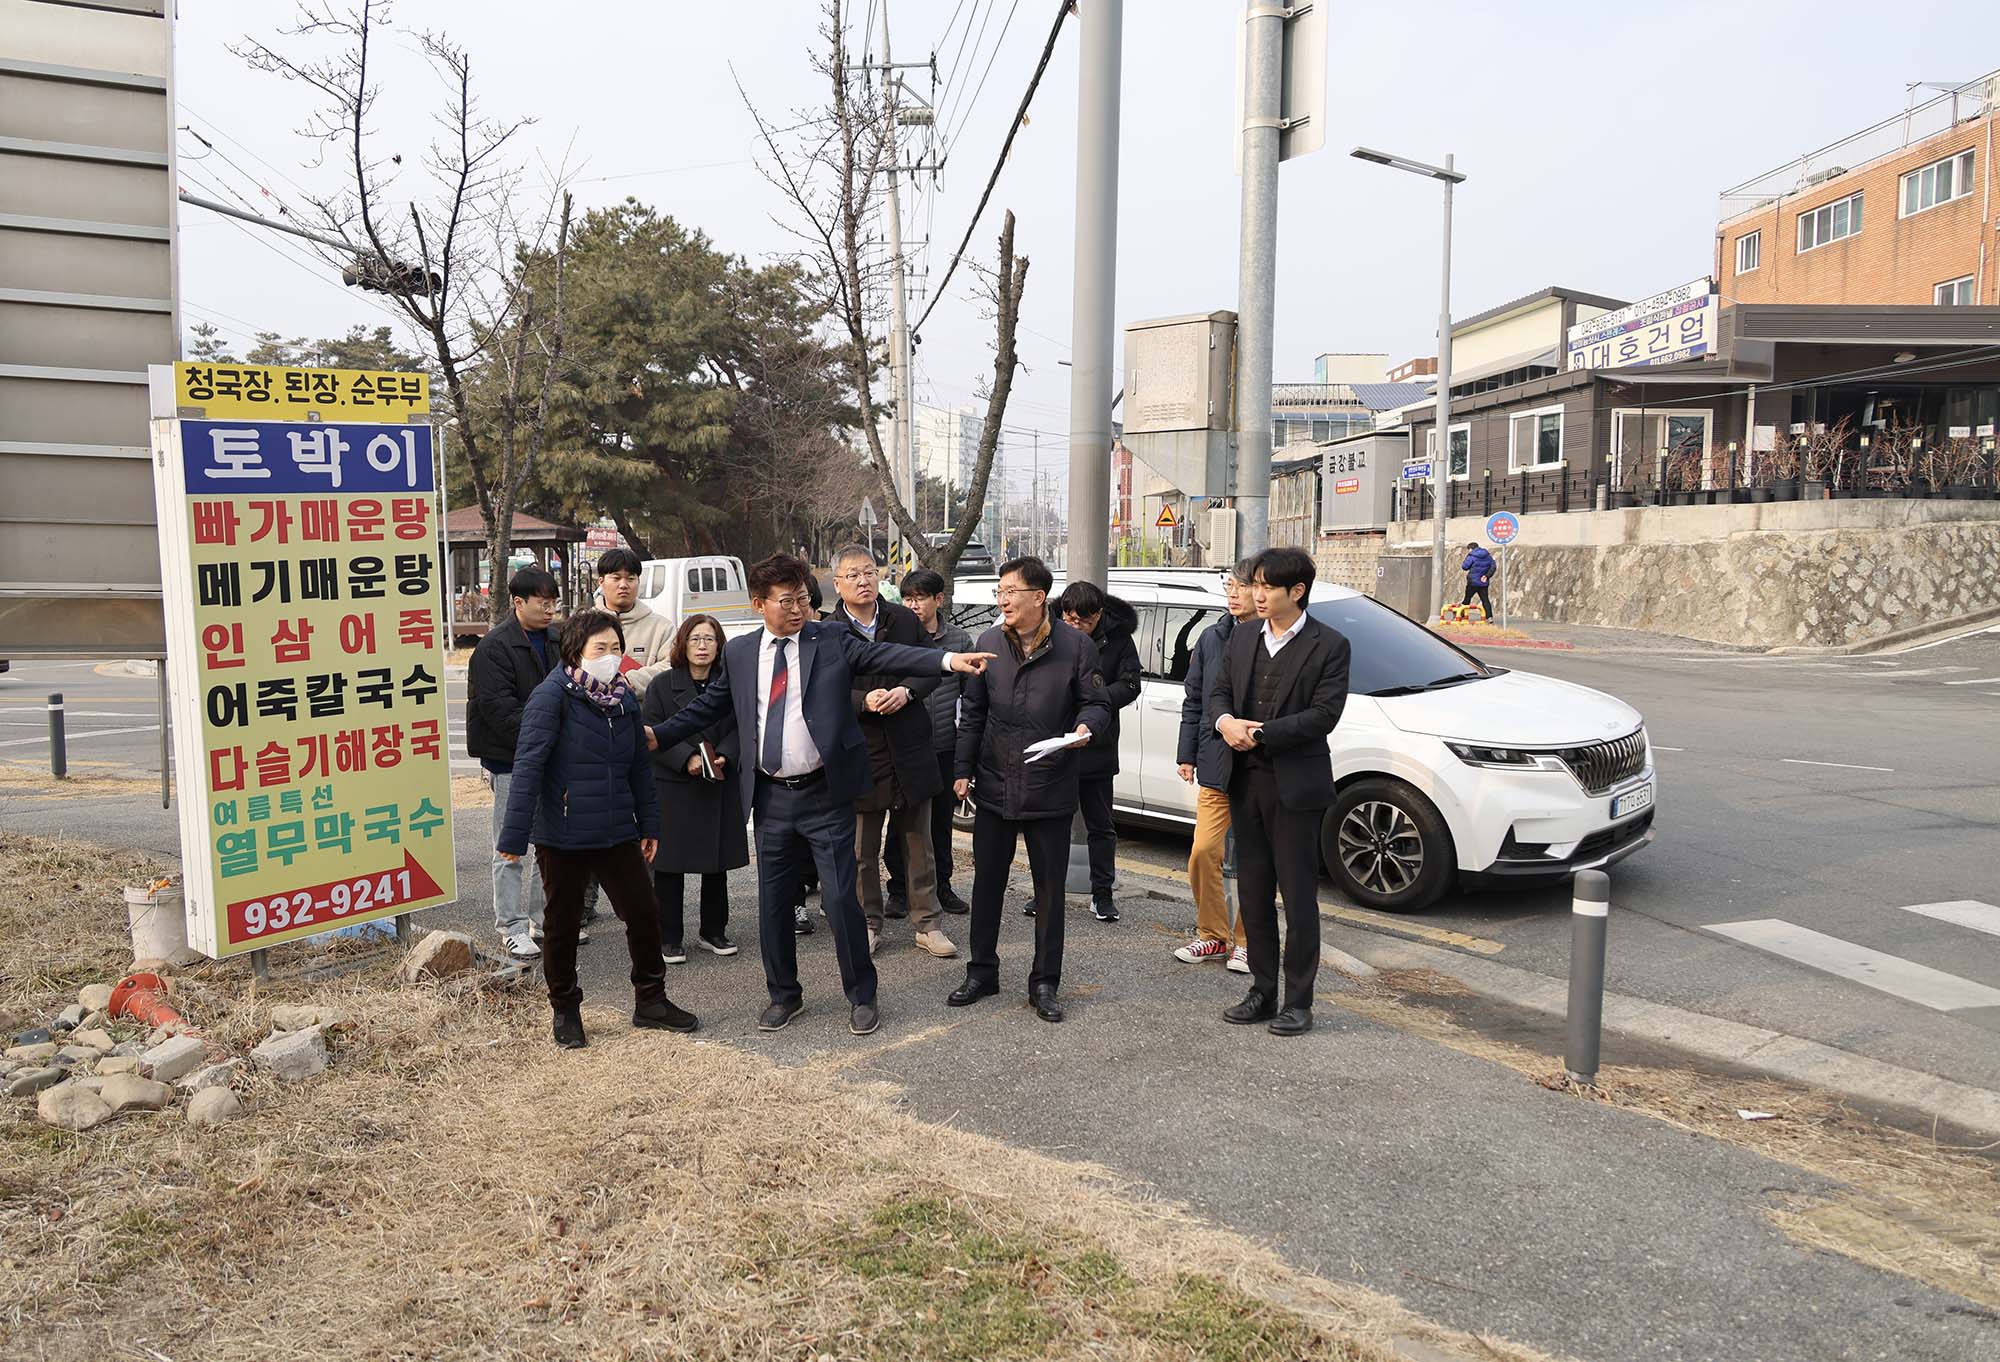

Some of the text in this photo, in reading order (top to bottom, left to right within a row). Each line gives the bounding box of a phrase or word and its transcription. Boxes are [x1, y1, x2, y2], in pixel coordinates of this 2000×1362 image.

[1592, 312, 1704, 369] 대호건업
[203, 427, 418, 488] 토박이
[1328, 450, 1366, 474] 금강불교
[192, 497, 431, 546] 빠가매운탕
[197, 553, 433, 607] 메기매운탕
[201, 608, 435, 670] 인삼어죽
[206, 664, 438, 728] 어죽칼국수
[209, 719, 441, 792] 다슬기해장국
[213, 783, 334, 826] 여름특선
[215, 796, 445, 879] 열무막국수
[244, 869, 412, 936] 932-9241
